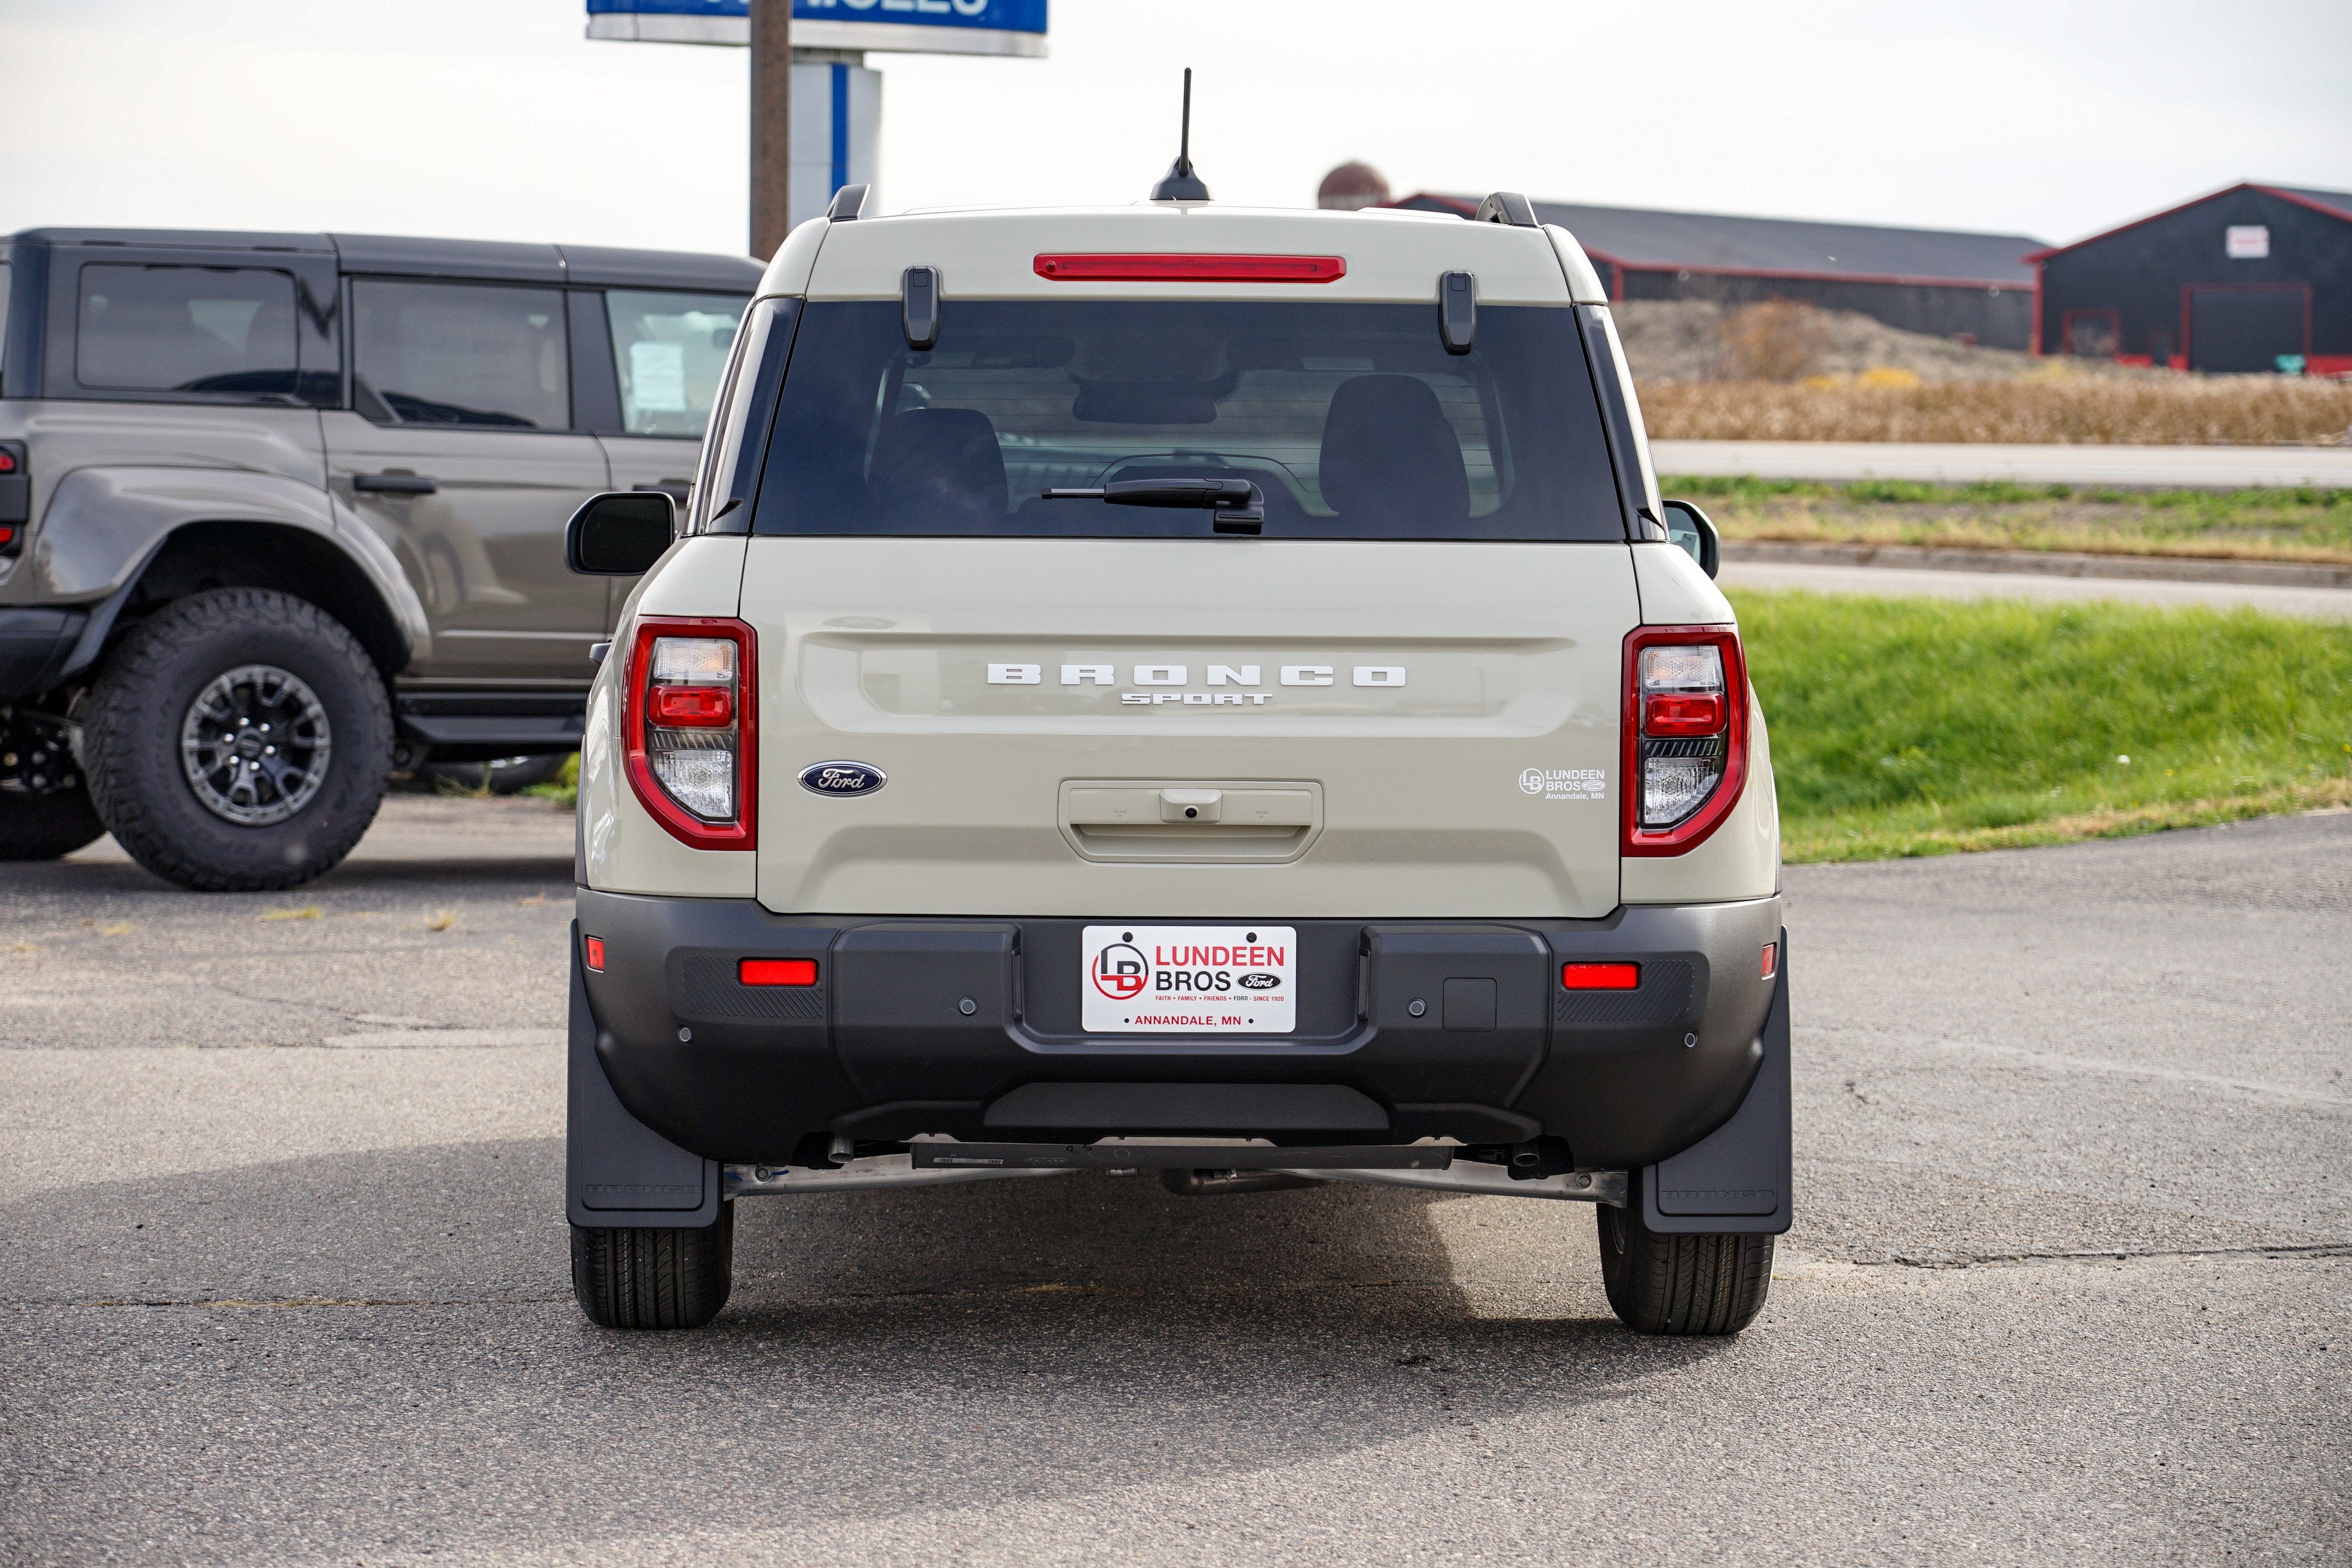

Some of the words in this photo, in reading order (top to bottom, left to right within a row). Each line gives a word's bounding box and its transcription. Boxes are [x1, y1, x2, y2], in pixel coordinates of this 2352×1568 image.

[987, 663, 1406, 687] BRONCO
[1121, 693, 1273, 705] SPORT
[817, 768, 866, 788] Ford
[1546, 770, 1605, 780] LUNDEEN
[1546, 781, 1581, 791] BROS
[1156, 946, 1284, 966] LUNDEEN
[1156, 971, 1231, 991] BROS
[1134, 1015, 1217, 1027] ANNANDALE,
[1221, 1016, 1242, 1025] MN
[586, 1184, 701, 1193] BRONCO
